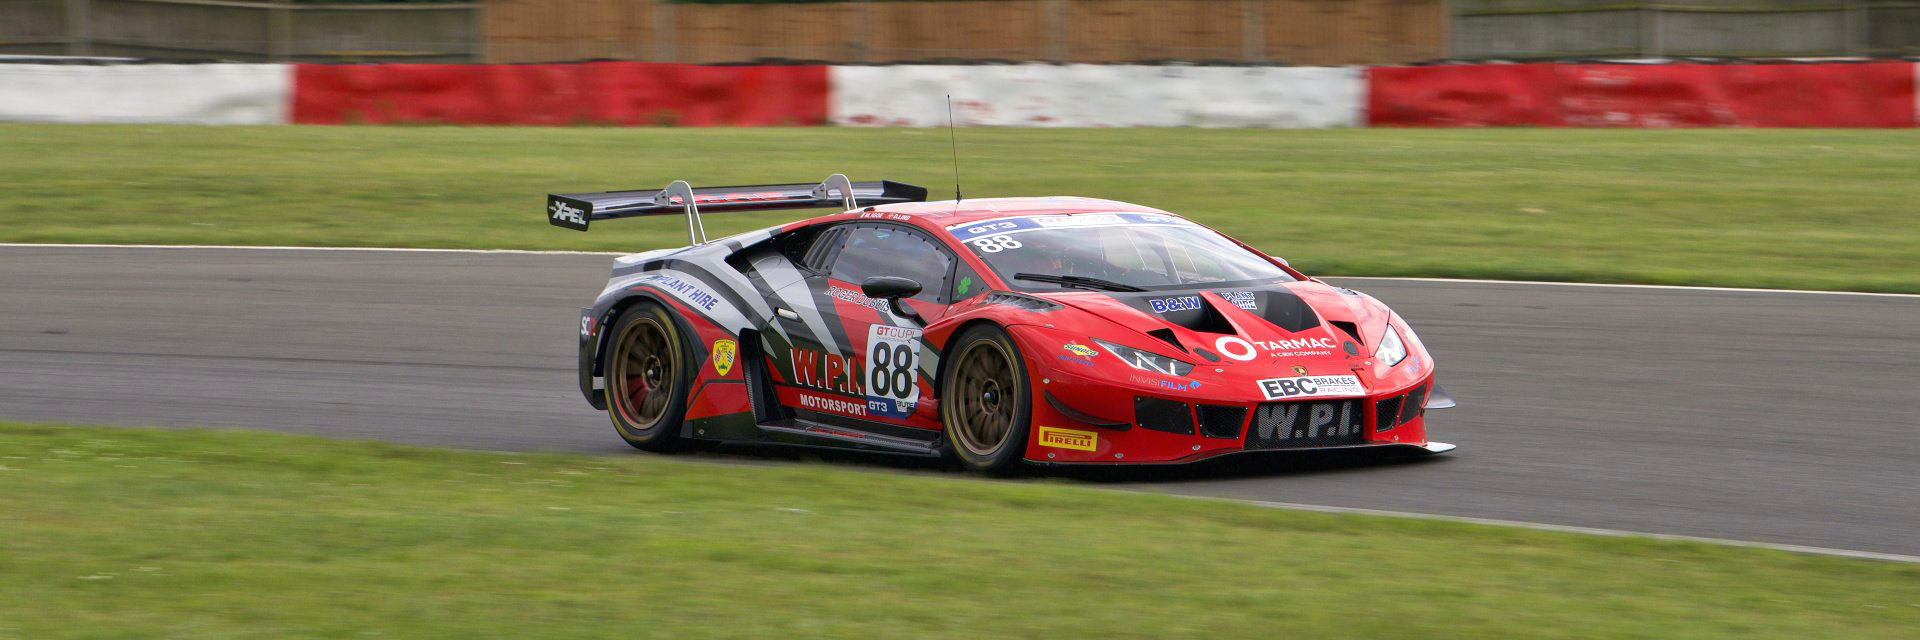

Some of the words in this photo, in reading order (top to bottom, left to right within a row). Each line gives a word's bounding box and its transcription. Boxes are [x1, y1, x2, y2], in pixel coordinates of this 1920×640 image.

[552, 200, 586, 225] XPEL
[967, 221, 1018, 234] GT3
[973, 235, 1022, 253] 88
[689, 287, 718, 311] HIRE
[824, 286, 859, 302] ROGER
[1221, 292, 1255, 300] PLANT
[1149, 296, 1200, 313] B&W
[1231, 300, 1257, 309] HIRE
[1064, 343, 1098, 356] SUNOCO
[1255, 338, 1336, 350] TARMAC
[871, 342, 912, 399] 88
[1262, 378, 1317, 398] EBC
[1313, 377, 1356, 386] BRAKES
[800, 394, 867, 416] MOTORSPORT
[869, 400, 887, 412] GT3
[1257, 401, 1360, 439] W.P.I.
[1043, 430, 1092, 447] PIRELLI
